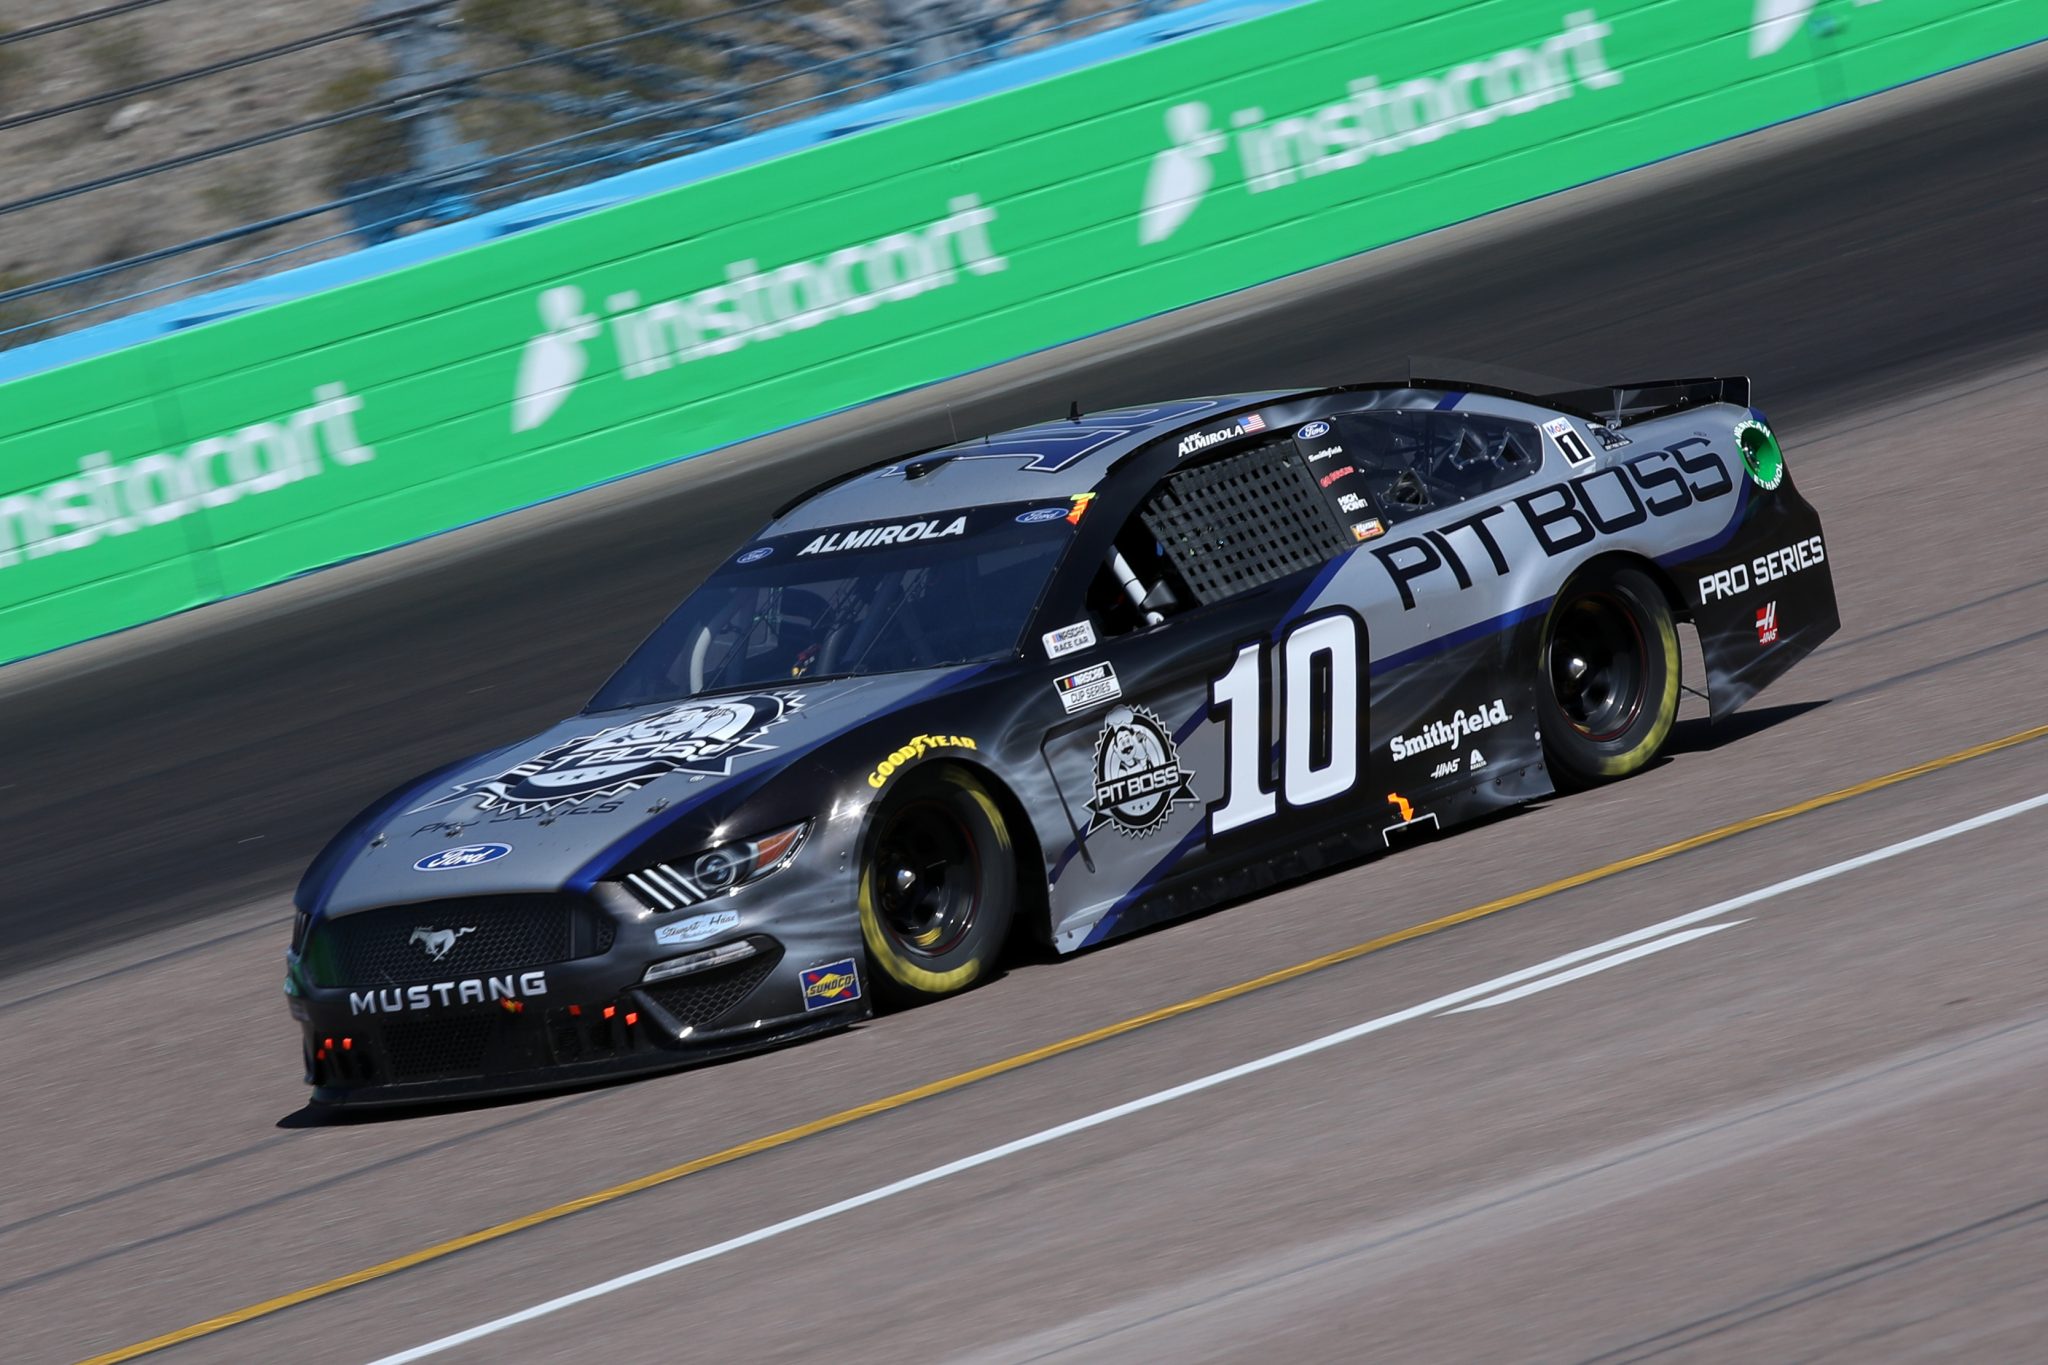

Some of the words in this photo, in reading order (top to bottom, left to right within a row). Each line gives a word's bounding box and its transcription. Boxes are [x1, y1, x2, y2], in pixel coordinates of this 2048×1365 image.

[1230, 8, 1622, 195] instacart
[605, 194, 1009, 380] instacart
[1178, 425, 1244, 457] ALMIROLA
[1184, 431, 1202, 443] ARIC
[1562, 434, 1583, 460] 1
[1733, 420, 1771, 448] AMERICAN
[0, 381, 375, 569] nstacart
[1753, 462, 1783, 490] ETHANOL
[1020, 508, 1063, 522] Ford
[1369, 505, 1509, 611] PIT
[1512, 438, 1733, 557] BOSS
[797, 516, 967, 556] ALMIROLA
[1699, 564, 1749, 605] PRO
[1753, 535, 1824, 586] SERIES
[1053, 640, 1073, 653] RACE
[1074, 636, 1088, 647] CAR
[1058, 625, 1087, 642] NASCAR
[1070, 691, 1085, 703] CUP
[1086, 681, 1111, 698] SERIES
[1074, 666, 1105, 686] NASCAR
[1213, 615, 1357, 835] 10
[1390, 699, 1509, 761] Smithfield
[868, 733, 977, 788] GOODYEAR
[1098, 781, 1126, 806] PIT
[1127, 765, 1179, 797] BOSS
[422, 845, 502, 870] Ford
[350, 970, 547, 1015] MUSTANG
[808, 974, 855, 998] SUNOCO
